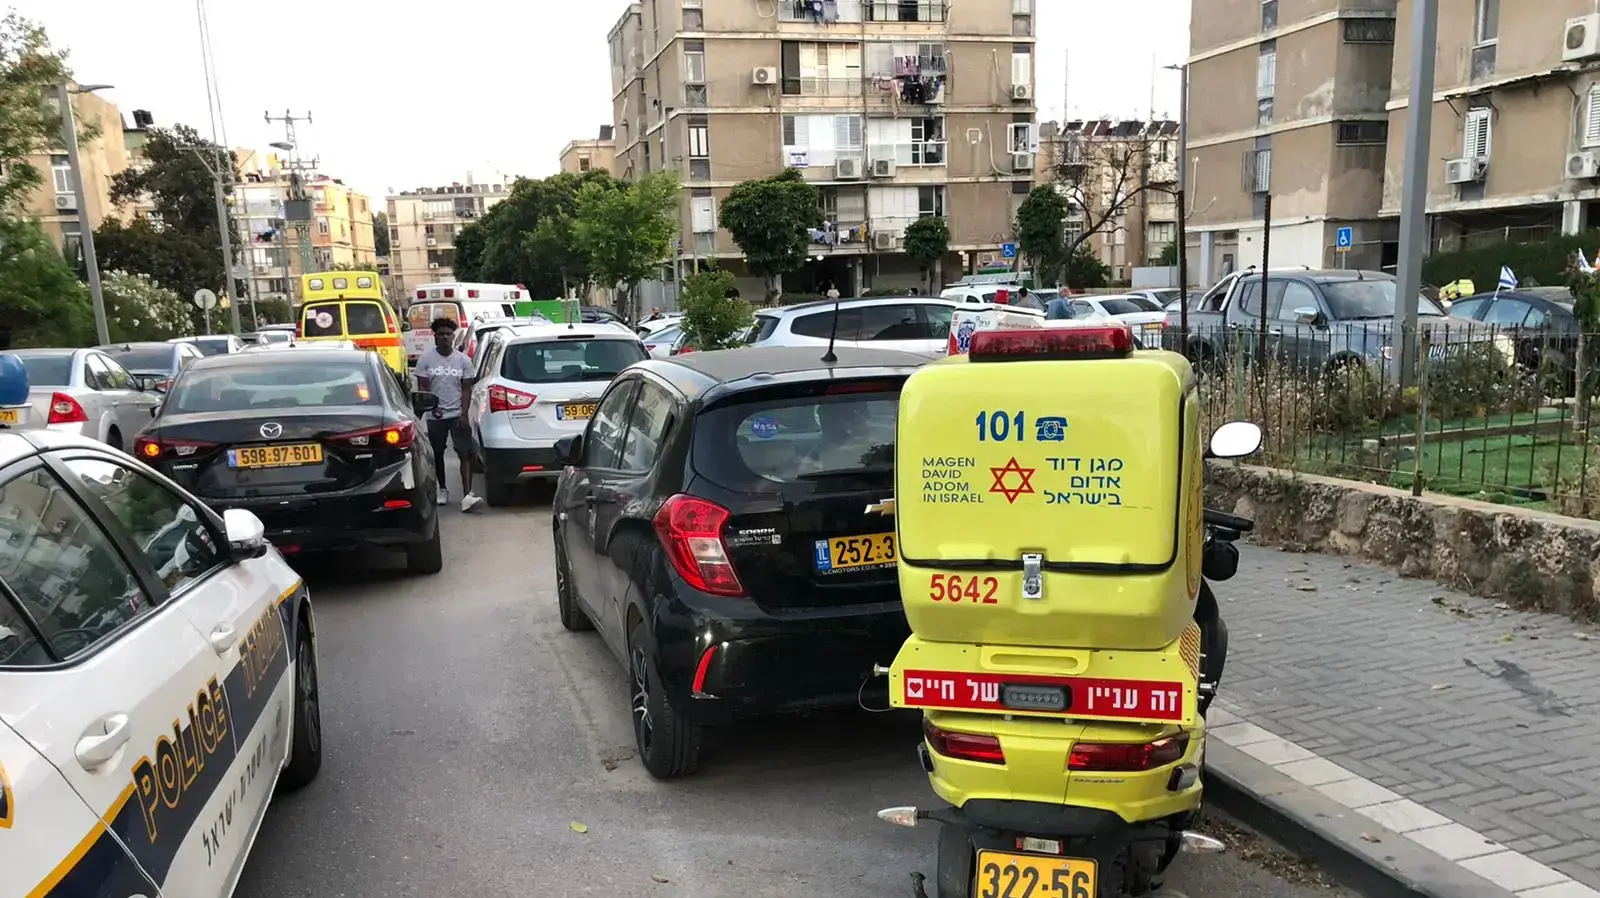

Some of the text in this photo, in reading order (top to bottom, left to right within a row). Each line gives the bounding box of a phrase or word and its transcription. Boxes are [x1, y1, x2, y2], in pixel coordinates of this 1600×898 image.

[427, 365, 463, 377] adidas
[753, 422, 778, 433] NASA
[975, 410, 1024, 442] 101
[922, 456, 976, 468] MAGEN
[1044, 457, 1123, 474] מגן דוד
[921, 469, 962, 479] DAVID
[1070, 475, 1121, 489] אדום
[922, 481, 969, 492] ADOM
[922, 492, 985, 504] IN ISRAEL
[1043, 489, 1122, 505] בישראל
[738, 527, 776, 535] SPARK
[928, 573, 999, 605] 5642
[966, 678, 999, 703] של
[1087, 685, 1138, 711] עניין
[1149, 689, 1179, 713] זה
[130, 673, 229, 844] POLICE
[202, 789, 236, 868] ישראל
